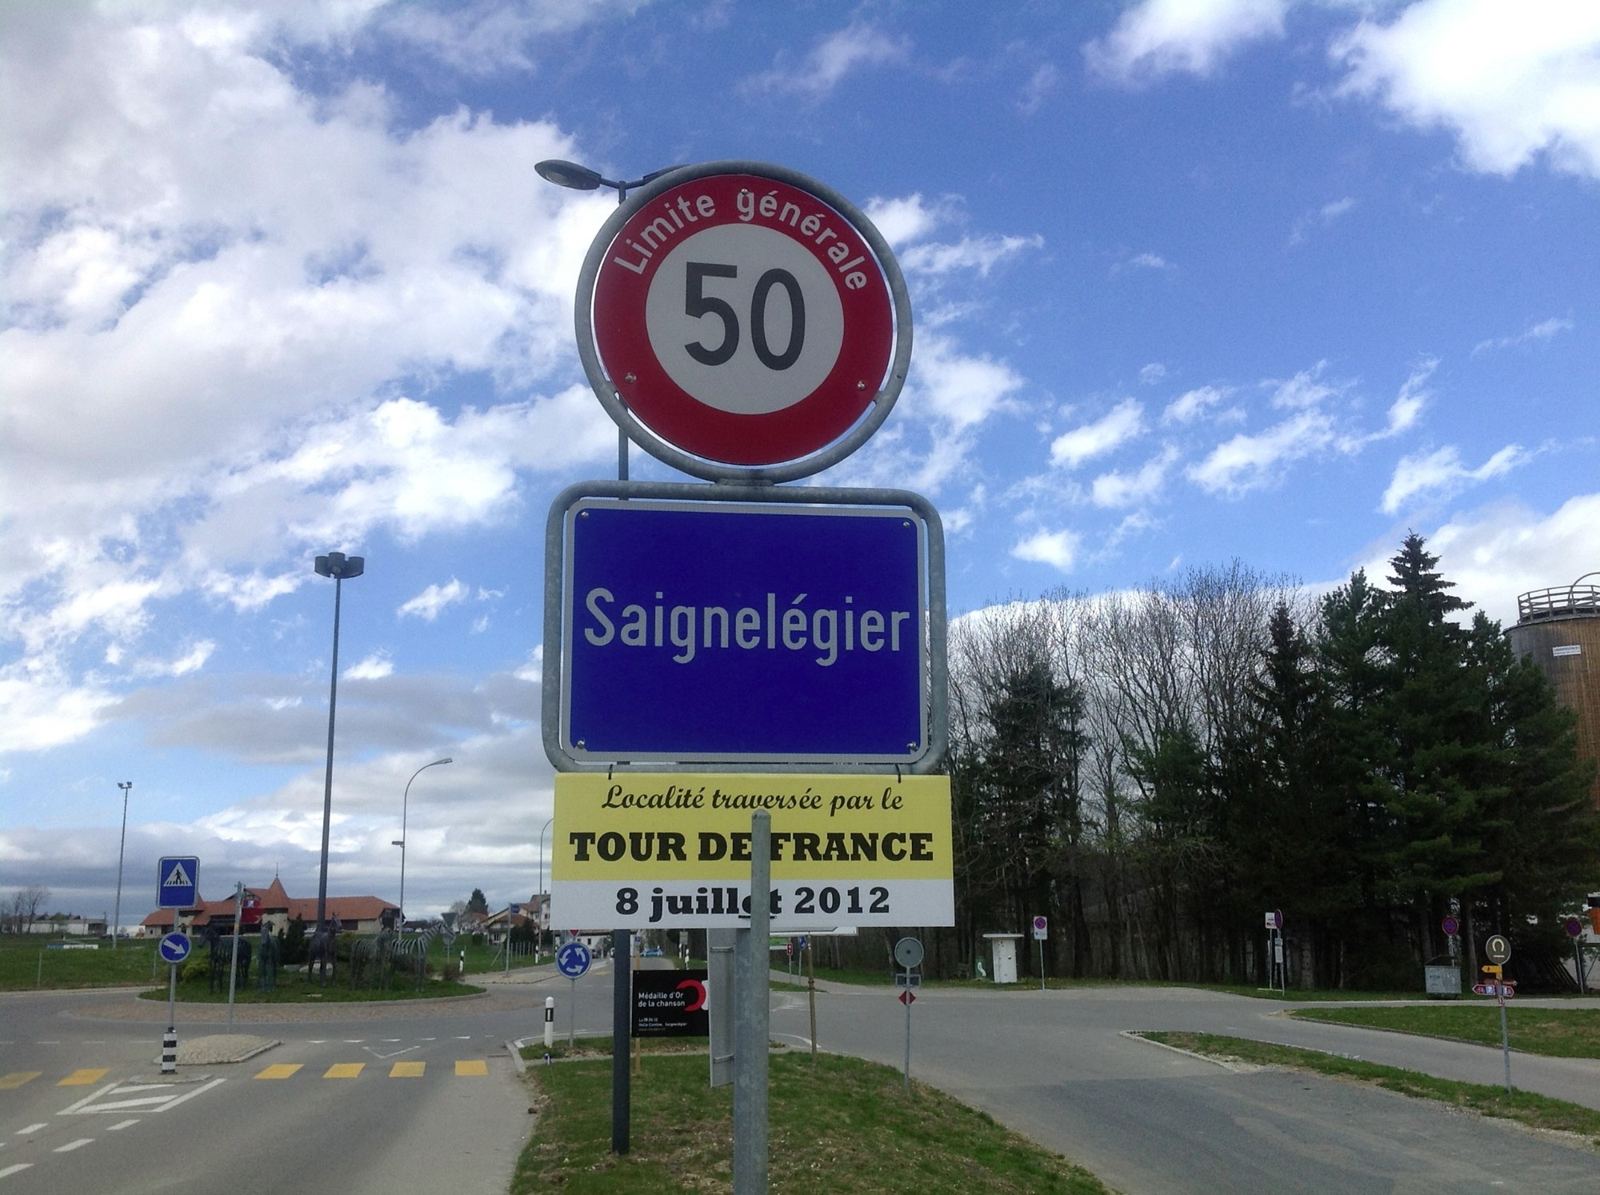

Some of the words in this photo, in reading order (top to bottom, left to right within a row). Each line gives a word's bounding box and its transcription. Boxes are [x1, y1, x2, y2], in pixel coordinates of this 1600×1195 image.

[613, 194, 716, 275] Limite
[736, 189, 868, 290] générale
[684, 261, 806, 371] 50
[584, 587, 910, 667] Saignelégier
[601, 784, 706, 809] Localité
[712, 787, 823, 810] traversée
[829, 793, 875, 817] par
[881, 786, 904, 810] le
[569, 832, 687, 861] TOUR
[698, 832, 752, 861] DE
[770, 832, 934, 861] FRANCE
[615, 887, 639, 915] 8
[794, 886, 890, 914] 2012
[638, 1000, 647, 1008] de
